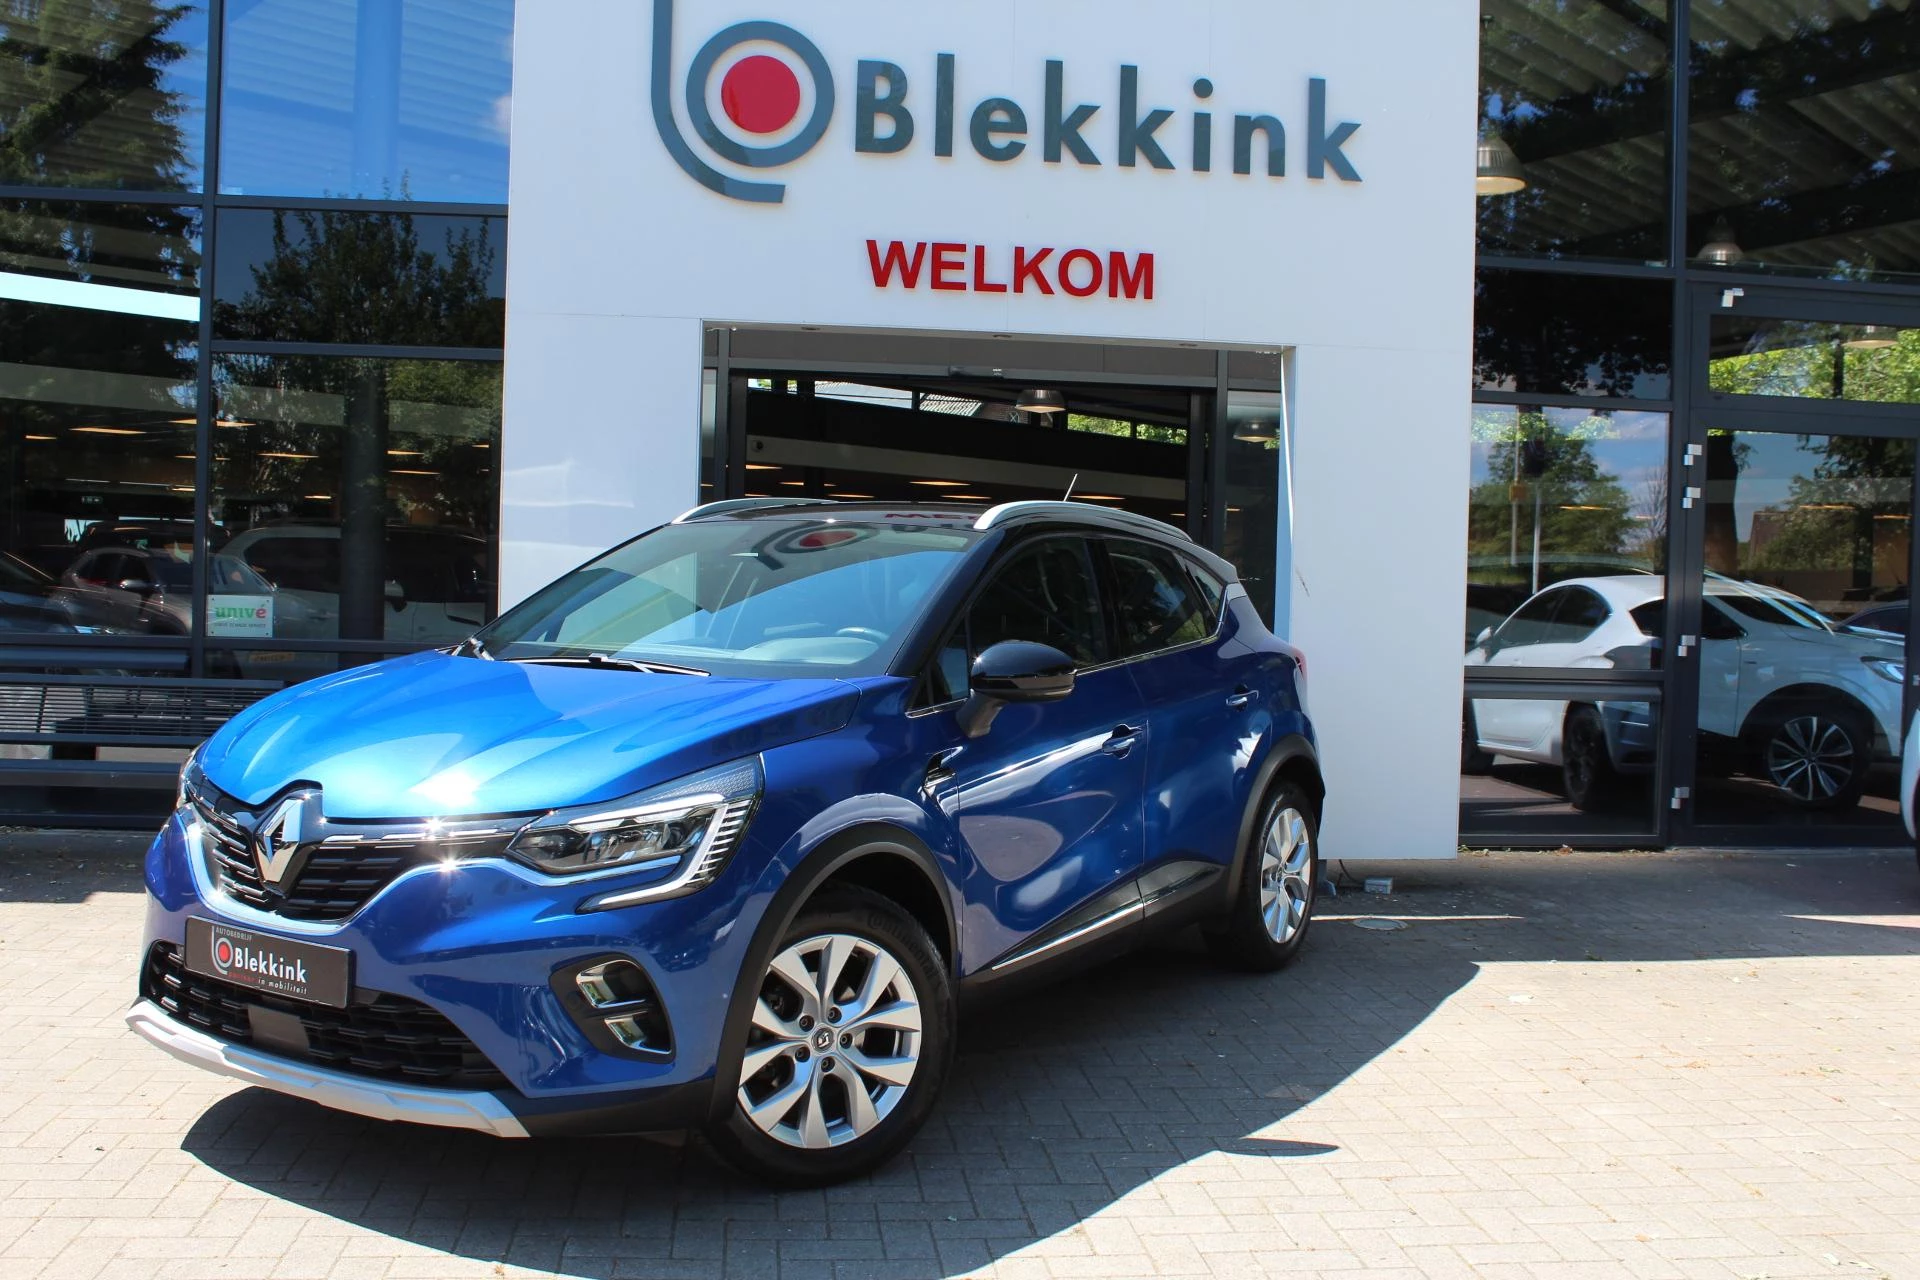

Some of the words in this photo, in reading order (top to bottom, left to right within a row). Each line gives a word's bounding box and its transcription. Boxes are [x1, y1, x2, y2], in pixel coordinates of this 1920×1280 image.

[855, 53, 1363, 183] Blekkink
[866, 239, 1155, 300] WELKOM
[215, 603, 267, 619] univé
[216, 927, 252, 941] AUTOBEDRIJF
[235, 947, 306, 983] Blekkink
[269, 981, 307, 995] mobiliteit
